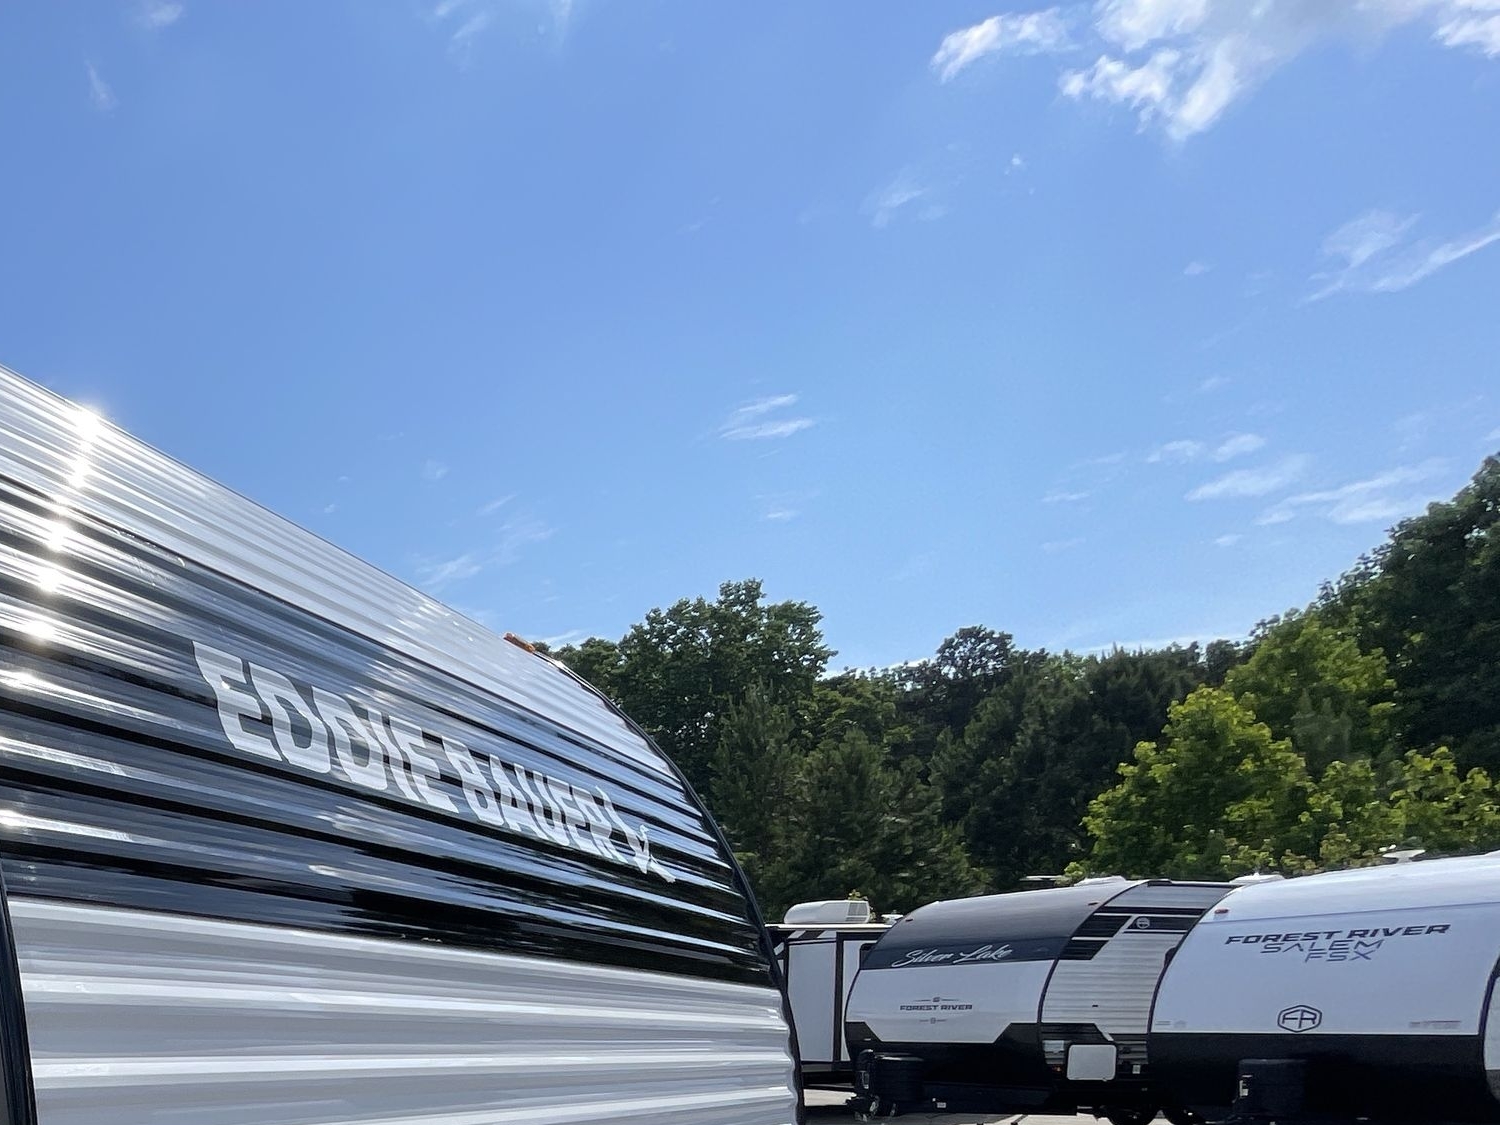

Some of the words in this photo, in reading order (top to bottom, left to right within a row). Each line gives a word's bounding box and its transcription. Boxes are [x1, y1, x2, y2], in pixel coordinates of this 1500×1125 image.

[192, 641, 459, 814] EDDIE
[442, 736, 628, 864] BAUER
[1225, 930, 1342, 945] FOREST
[1347, 924, 1451, 939] RIVER
[892, 949, 954, 968] Silver
[953, 944, 1012, 964] Lake
[1260, 939, 1385, 954] SALEM
[1305, 949, 1376, 963] FSX
